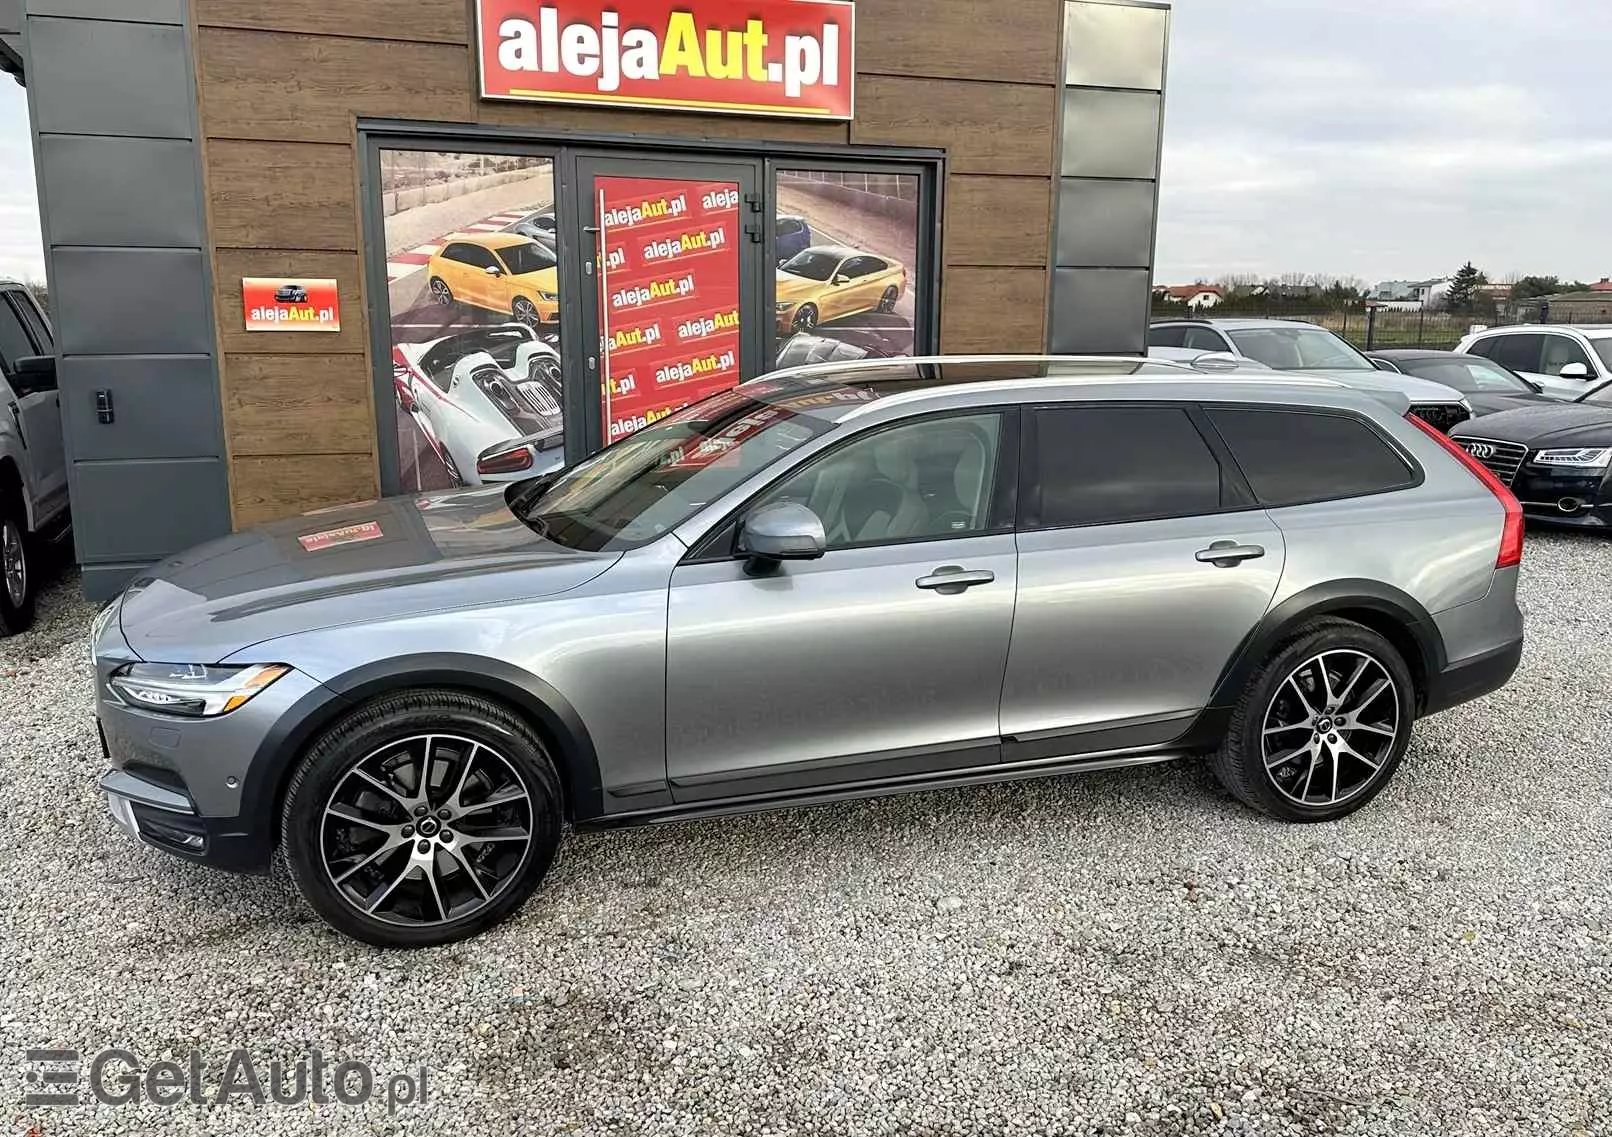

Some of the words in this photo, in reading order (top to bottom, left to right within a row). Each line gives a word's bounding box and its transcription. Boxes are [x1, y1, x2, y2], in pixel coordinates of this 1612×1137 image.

[498, 7, 838, 97] alejaAut.pl
[605, 195, 687, 226] alejaAut.pl
[643, 227, 725, 259] alejaAut.pl
[612, 275, 695, 307] alejaAut.pl
[251, 306, 334, 324] alejaAut.pl
[678, 311, 739, 338] alejaAut
[656, 351, 735, 383] alejaAut.pl
